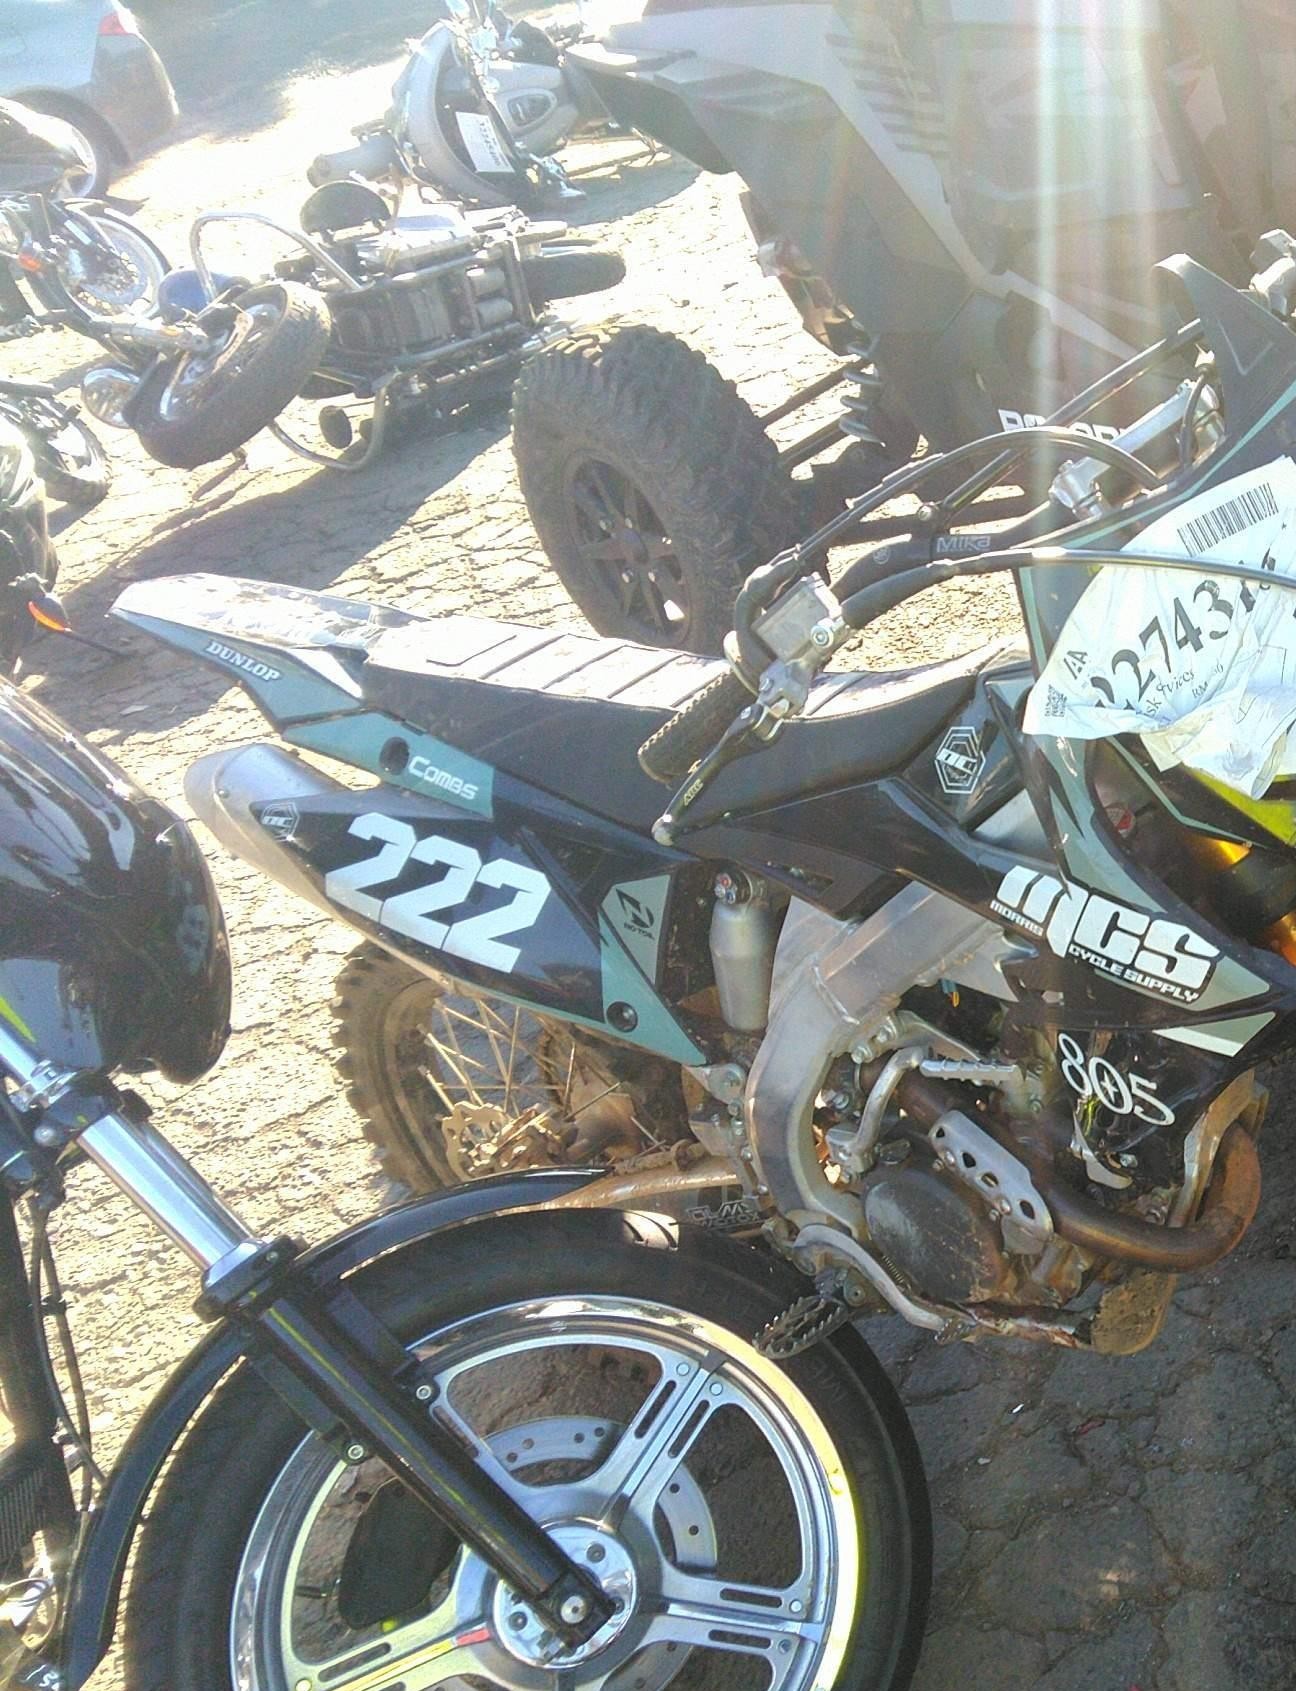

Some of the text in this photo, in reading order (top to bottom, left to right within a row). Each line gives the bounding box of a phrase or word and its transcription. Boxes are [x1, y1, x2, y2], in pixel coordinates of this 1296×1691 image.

[206, 640, 282, 682] DUNLOP
[325, 811, 552, 974] 222
[996, 864, 1221, 989] MCS
[989, 900, 1200, 1003] MORRIS CYCLE SUPPLY
[1058, 1032, 1176, 1126] 805
